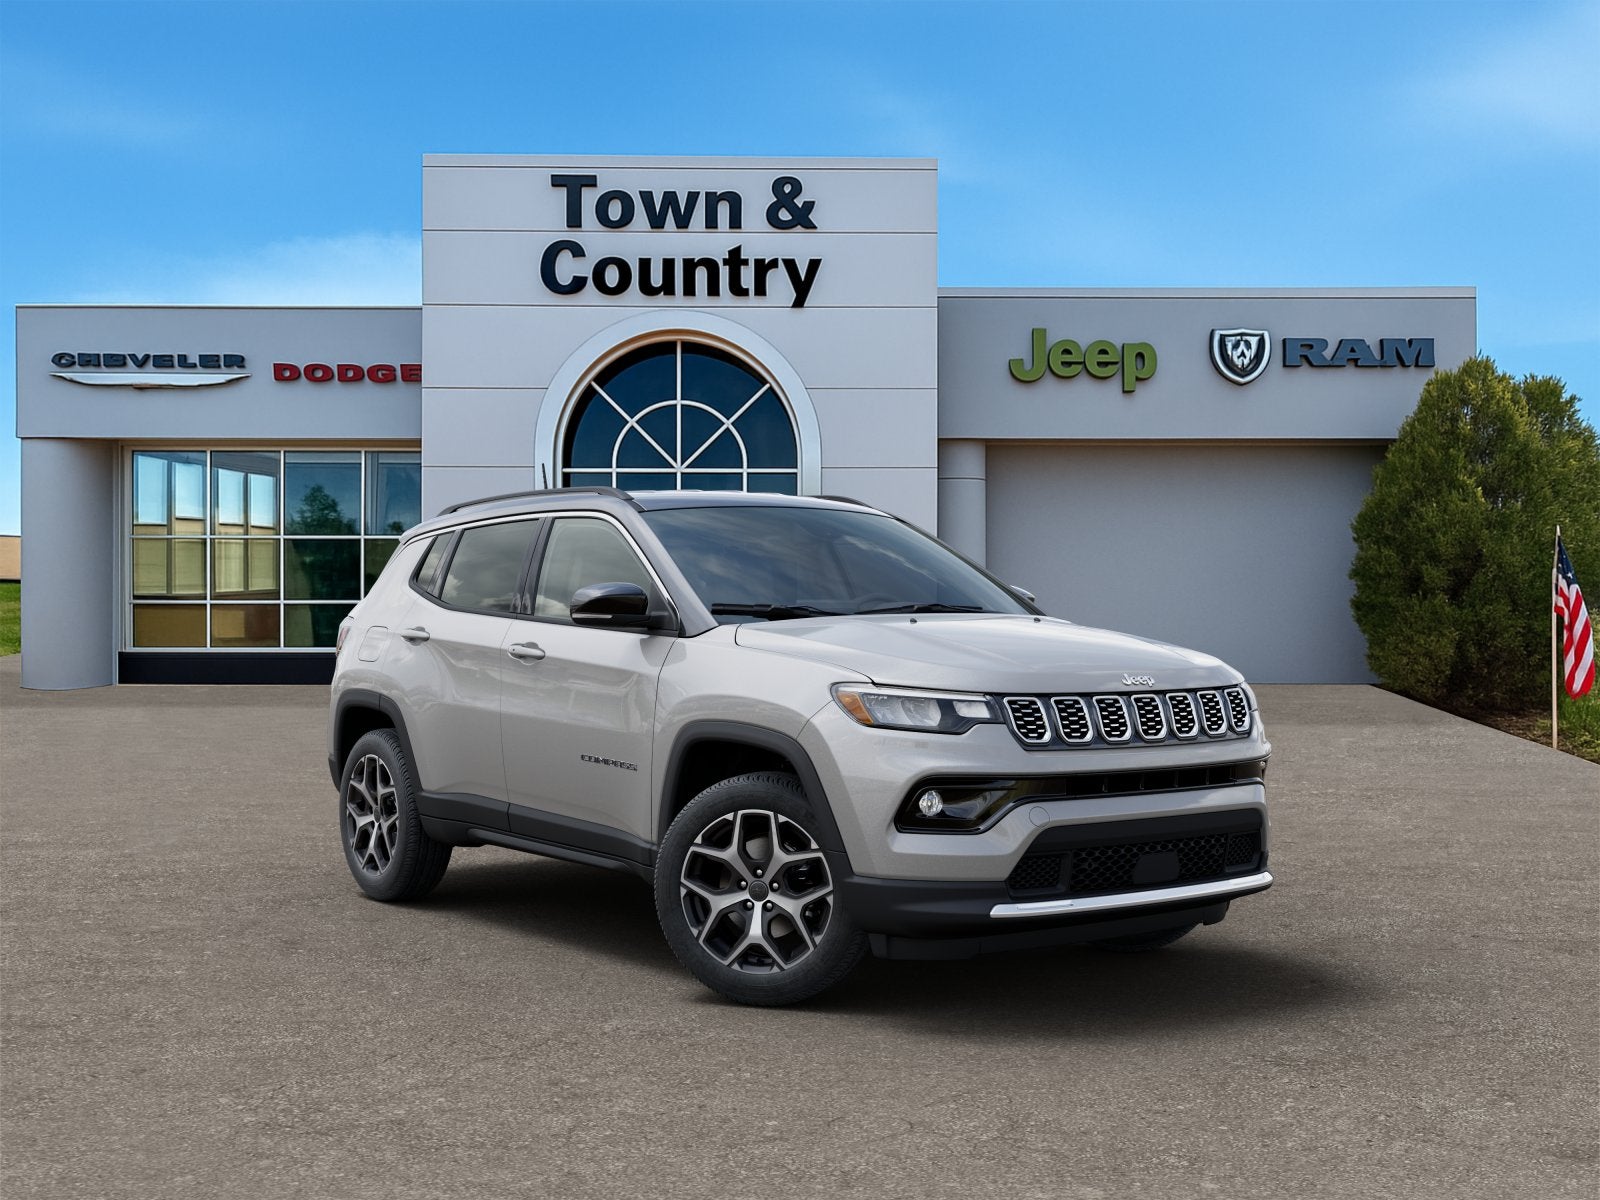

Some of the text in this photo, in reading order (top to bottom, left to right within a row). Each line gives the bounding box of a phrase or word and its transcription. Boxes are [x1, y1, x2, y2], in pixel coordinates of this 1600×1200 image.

[551, 174, 818, 230] Town &
[540, 239, 823, 309] Country
[1009, 328, 1158, 393] Jeep
[1283, 338, 1435, 368] RAM
[272, 363, 422, 383] DODGE
[1121, 673, 1155, 687] Jeep
[580, 754, 638, 772] COMPASS
